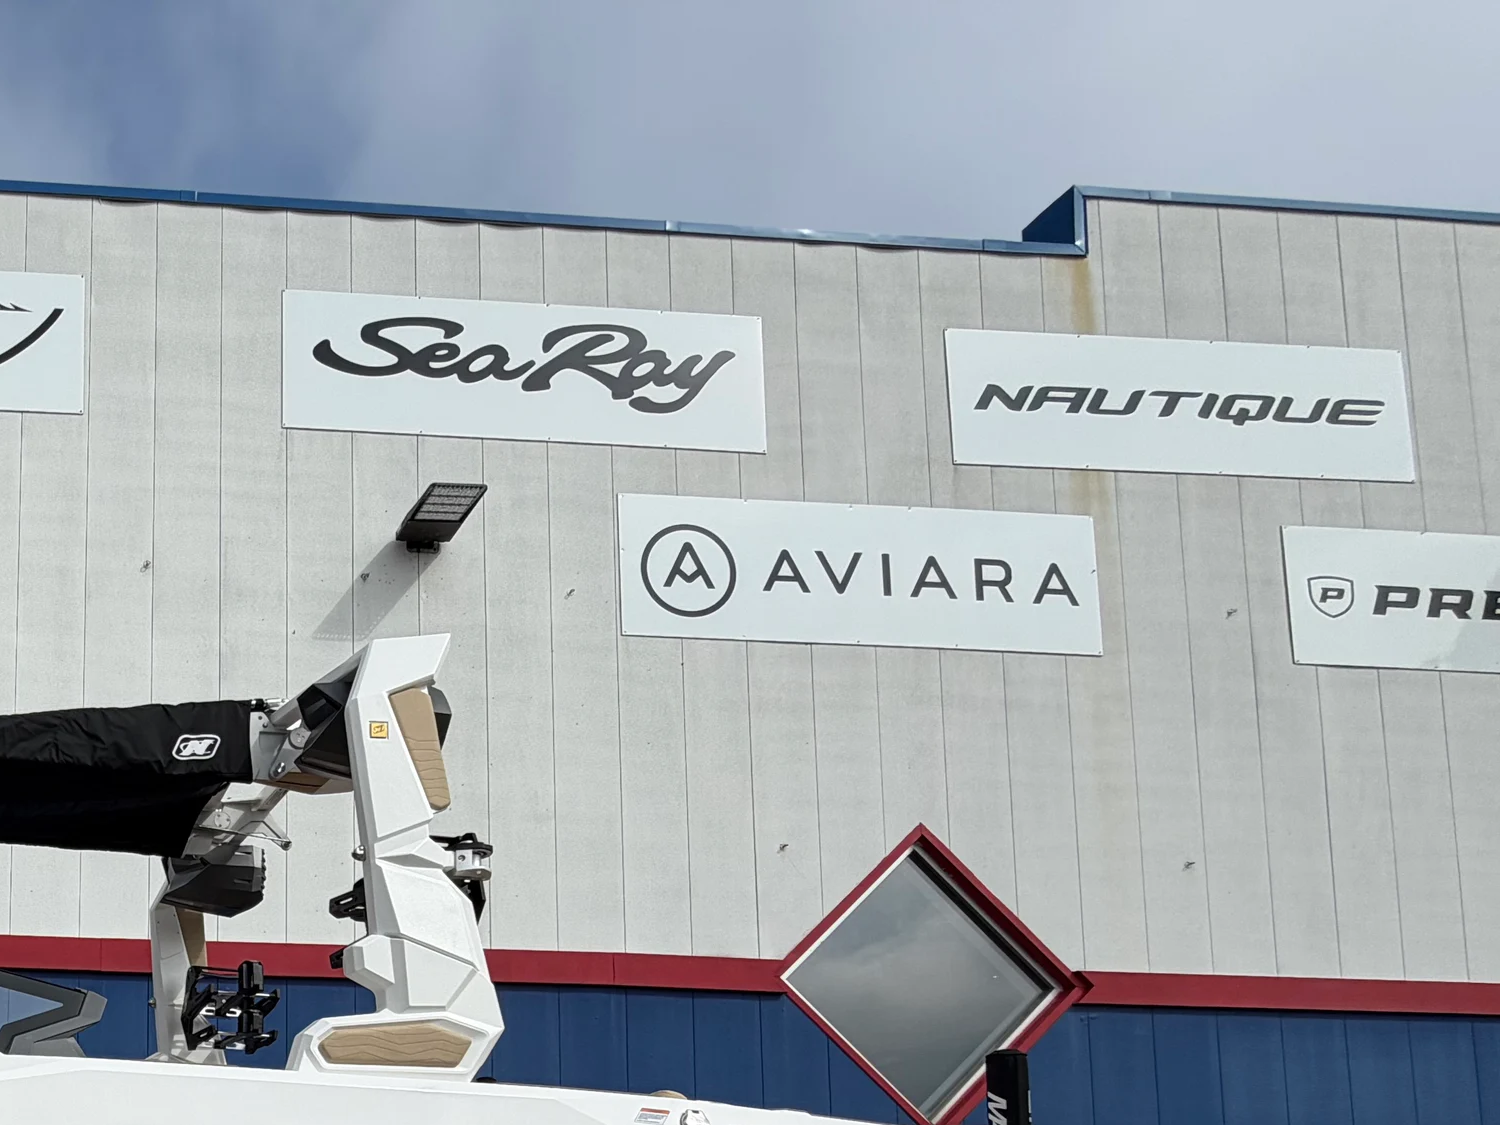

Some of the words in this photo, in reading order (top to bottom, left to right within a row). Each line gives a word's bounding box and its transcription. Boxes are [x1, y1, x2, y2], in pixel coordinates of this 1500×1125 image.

[312, 316, 536, 384] Sea
[521, 323, 736, 415] Ray
[973, 383, 1386, 426] NAUTIQUE
[762, 548, 1080, 607] AVIARA
